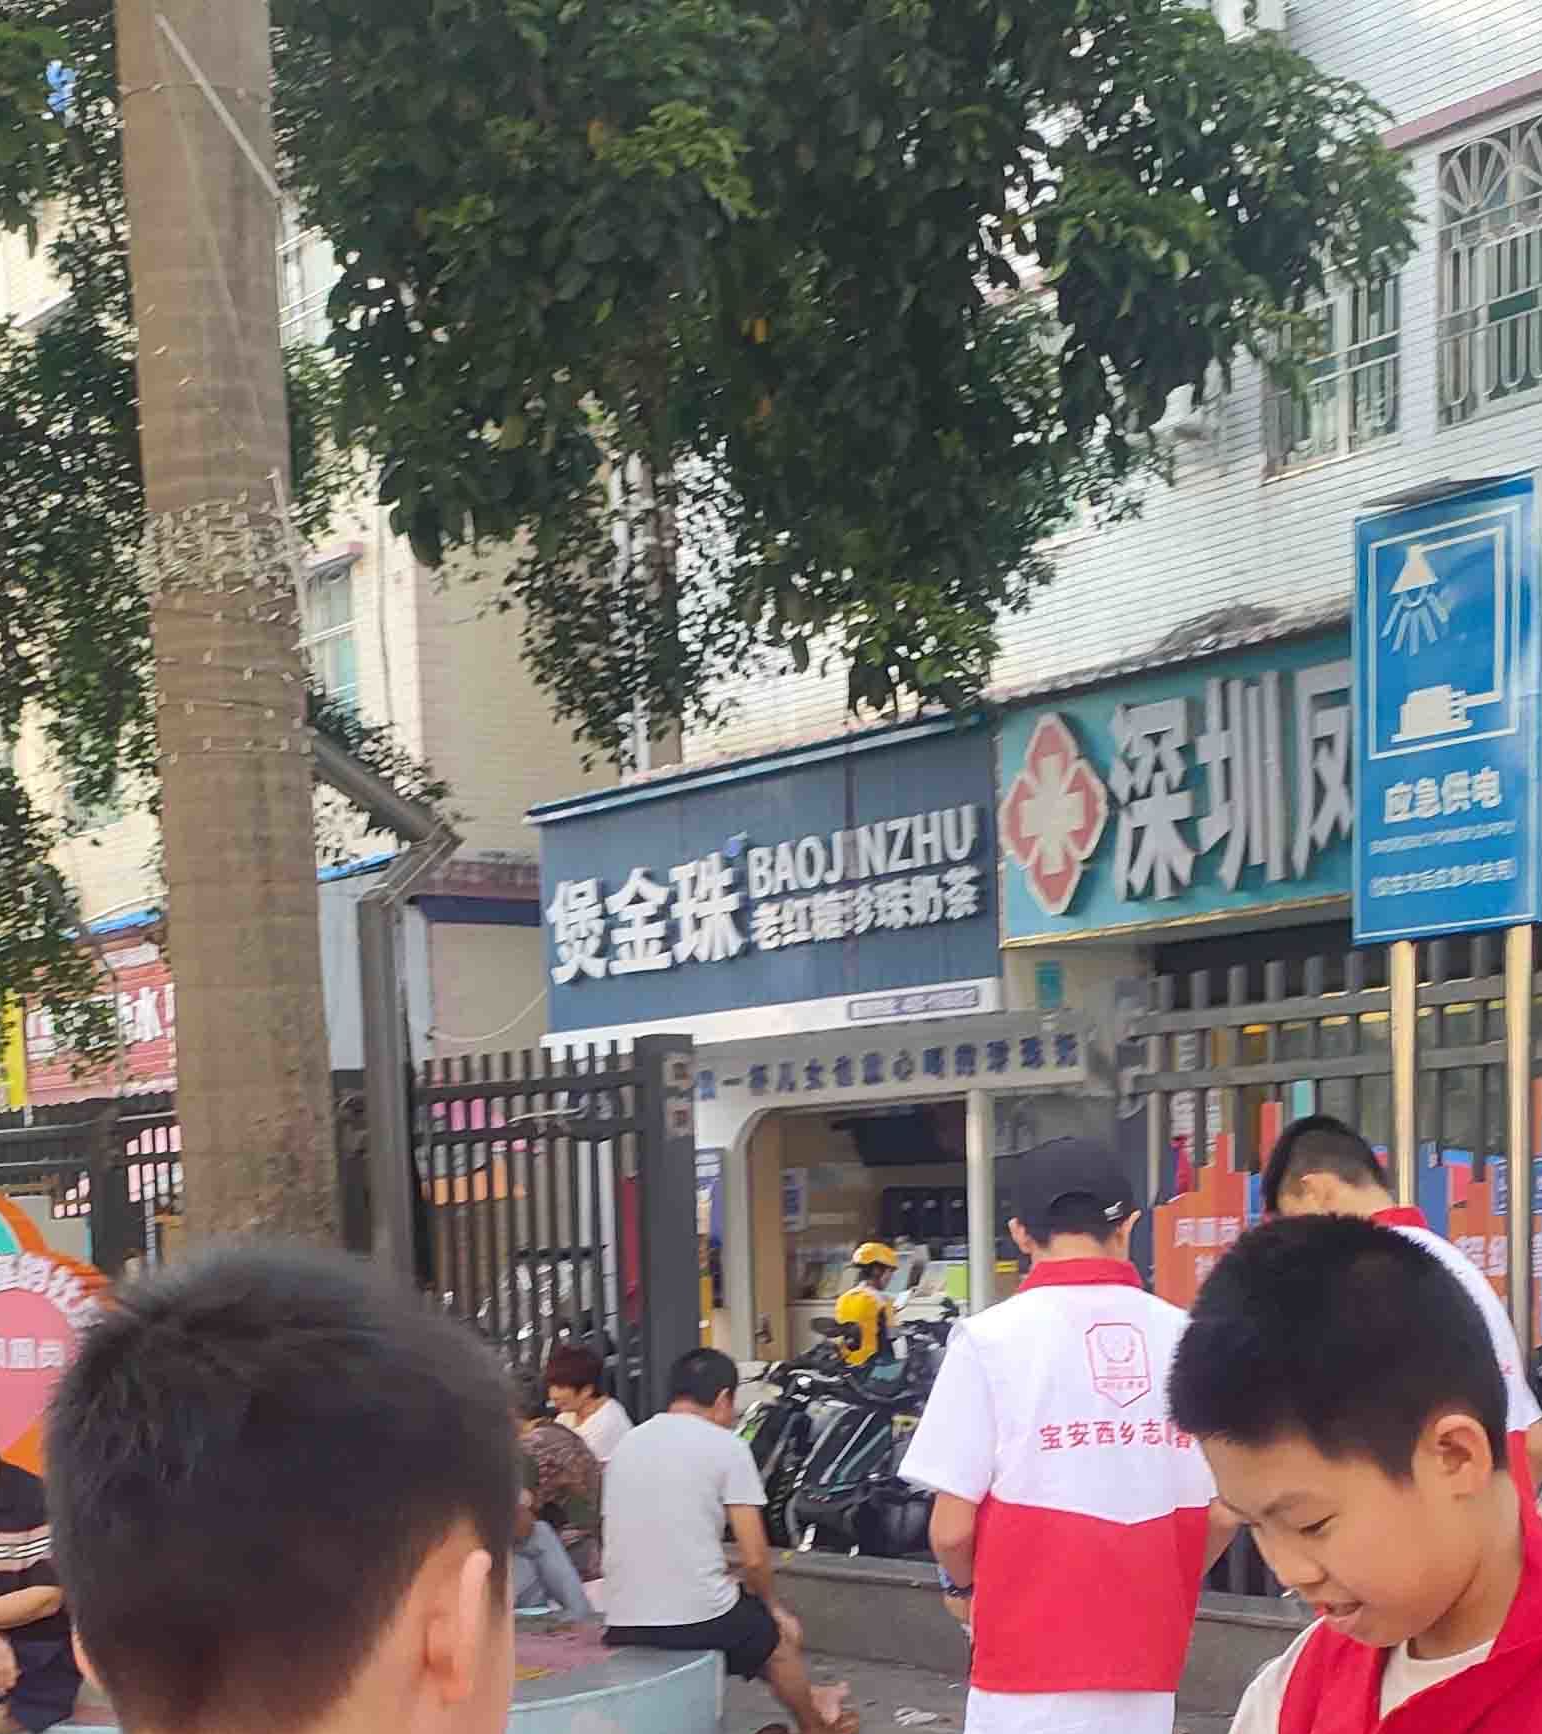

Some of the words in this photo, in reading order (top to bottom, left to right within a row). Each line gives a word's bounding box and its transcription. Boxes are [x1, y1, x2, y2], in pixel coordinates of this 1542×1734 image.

[1383, 766, 1503, 825] 应急供电
[546, 850, 746, 985] 煲金珠
[1037, 1418, 1195, 1452] 宝安西乡志者
